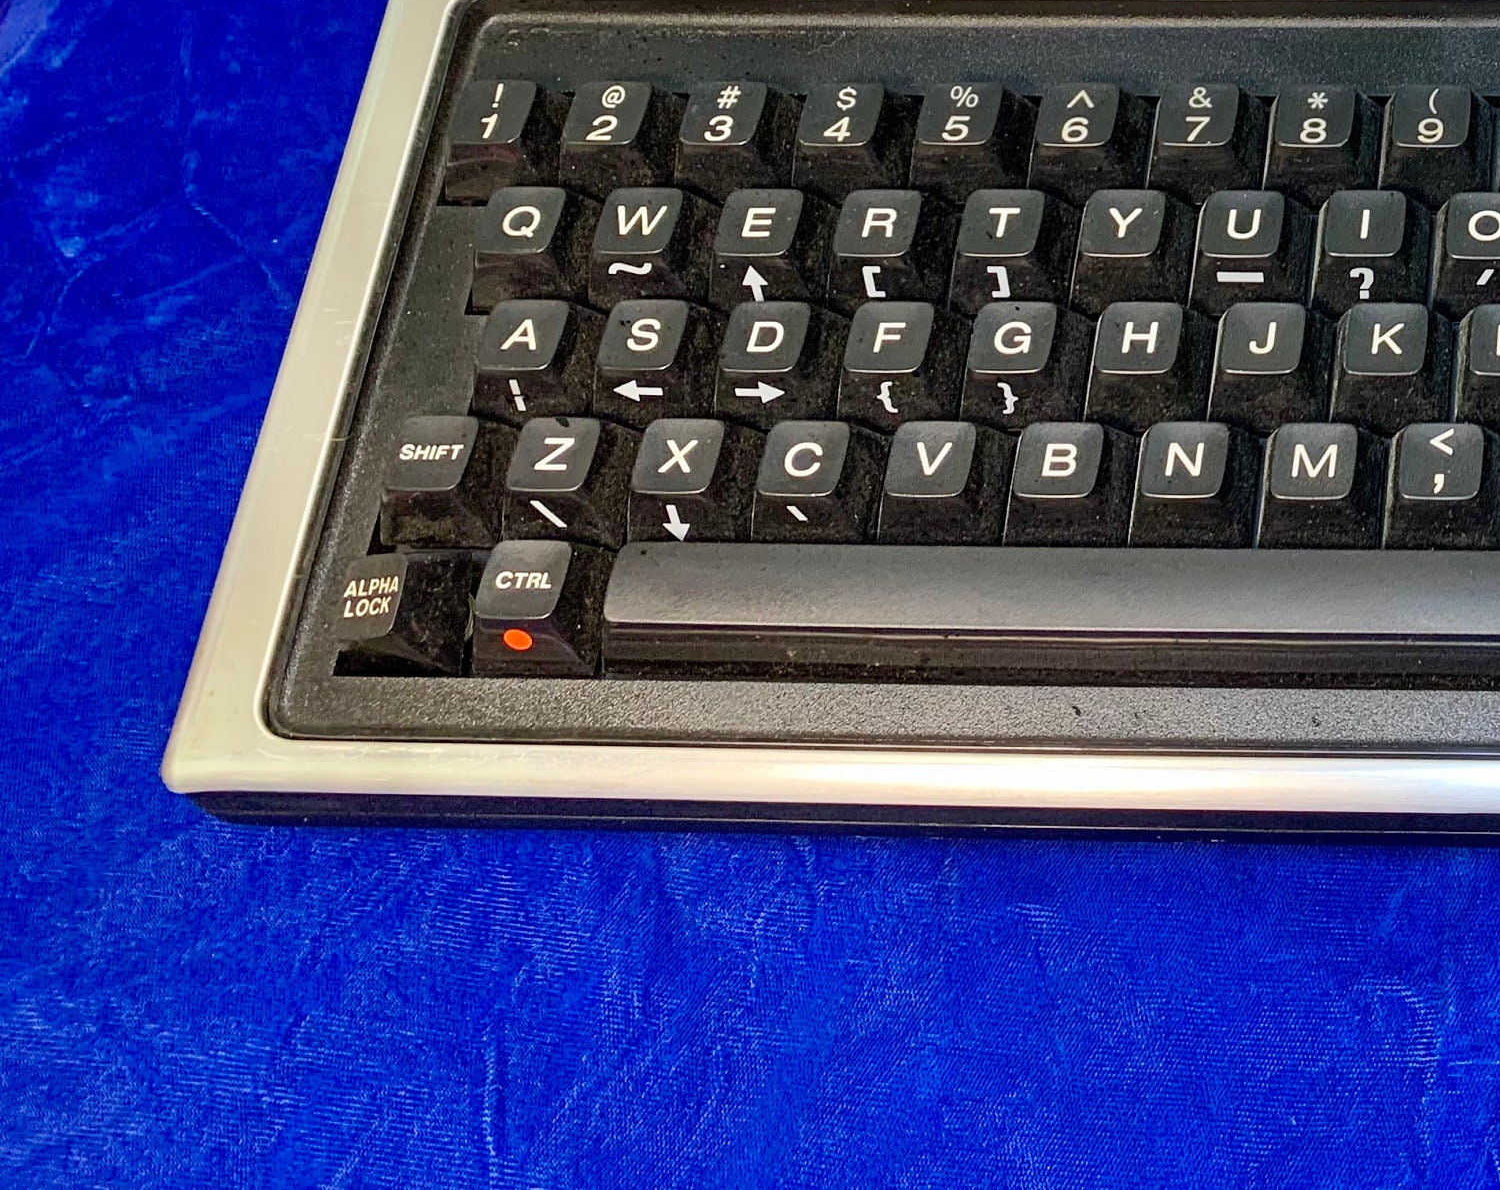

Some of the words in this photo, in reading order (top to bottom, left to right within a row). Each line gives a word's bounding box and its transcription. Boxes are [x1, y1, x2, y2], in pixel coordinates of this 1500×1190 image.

[492, 83, 504, 108] !
[601, 85, 626, 109] @
[716, 85, 741, 109] #
[836, 86, 857, 111] $
[950, 85, 979, 108] %
[1188, 86, 1212, 108] &
[1428, 88, 1439, 115] (
[481, 113, 498, 139] 1
[585, 115, 618, 141] 2
[704, 115, 734, 142] 3
[823, 116, 851, 142] 4
[941, 115, 971, 141] 5
[1061, 117, 1089, 143] 6
[1185, 116, 1211, 142] 7
[1299, 117, 1327, 144] 8
[1417, 117, 1444, 143] 9
[502, 205, 541, 238] Q
[617, 205, 668, 236] W
[741, 207, 777, 238] E
[861, 207, 897, 238] R
[988, 207, 1021, 238] T
[1109, 207, 1143, 238] Y
[1227, 208, 1262, 240] U
[1360, 209, 1371, 239] I
[861, 265, 887, 298] [
[986, 265, 1011, 298] ]
[1349, 267, 1374, 300] ?
[500, 319, 537, 351] A
[626, 318, 661, 351] S
[746, 321, 785, 353] D
[873, 322, 907, 353] F
[994, 321, 1032, 355] G
[1121, 321, 1159, 354] H
[1249, 321, 1277, 355] J
[1371, 323, 1405, 355] K
[876, 381, 899, 414] {
[997, 382, 1019, 415] }
[399, 443, 464, 461] SHIFT
[533, 437, 575, 471] Z
[657, 439, 699, 473] X
[1429, 428, 1455, 456] <
[784, 442, 823, 477] C
[916, 441, 953, 476] V
[1041, 443, 1077, 477] B
[1164, 442, 1205, 477] N
[1291, 443, 1338, 478] M
[529, 500, 568, 528] \
[343, 576, 399, 598] ALPHA
[495, 571, 552, 589] CTRL
[343, 596, 392, 618] LOCK
